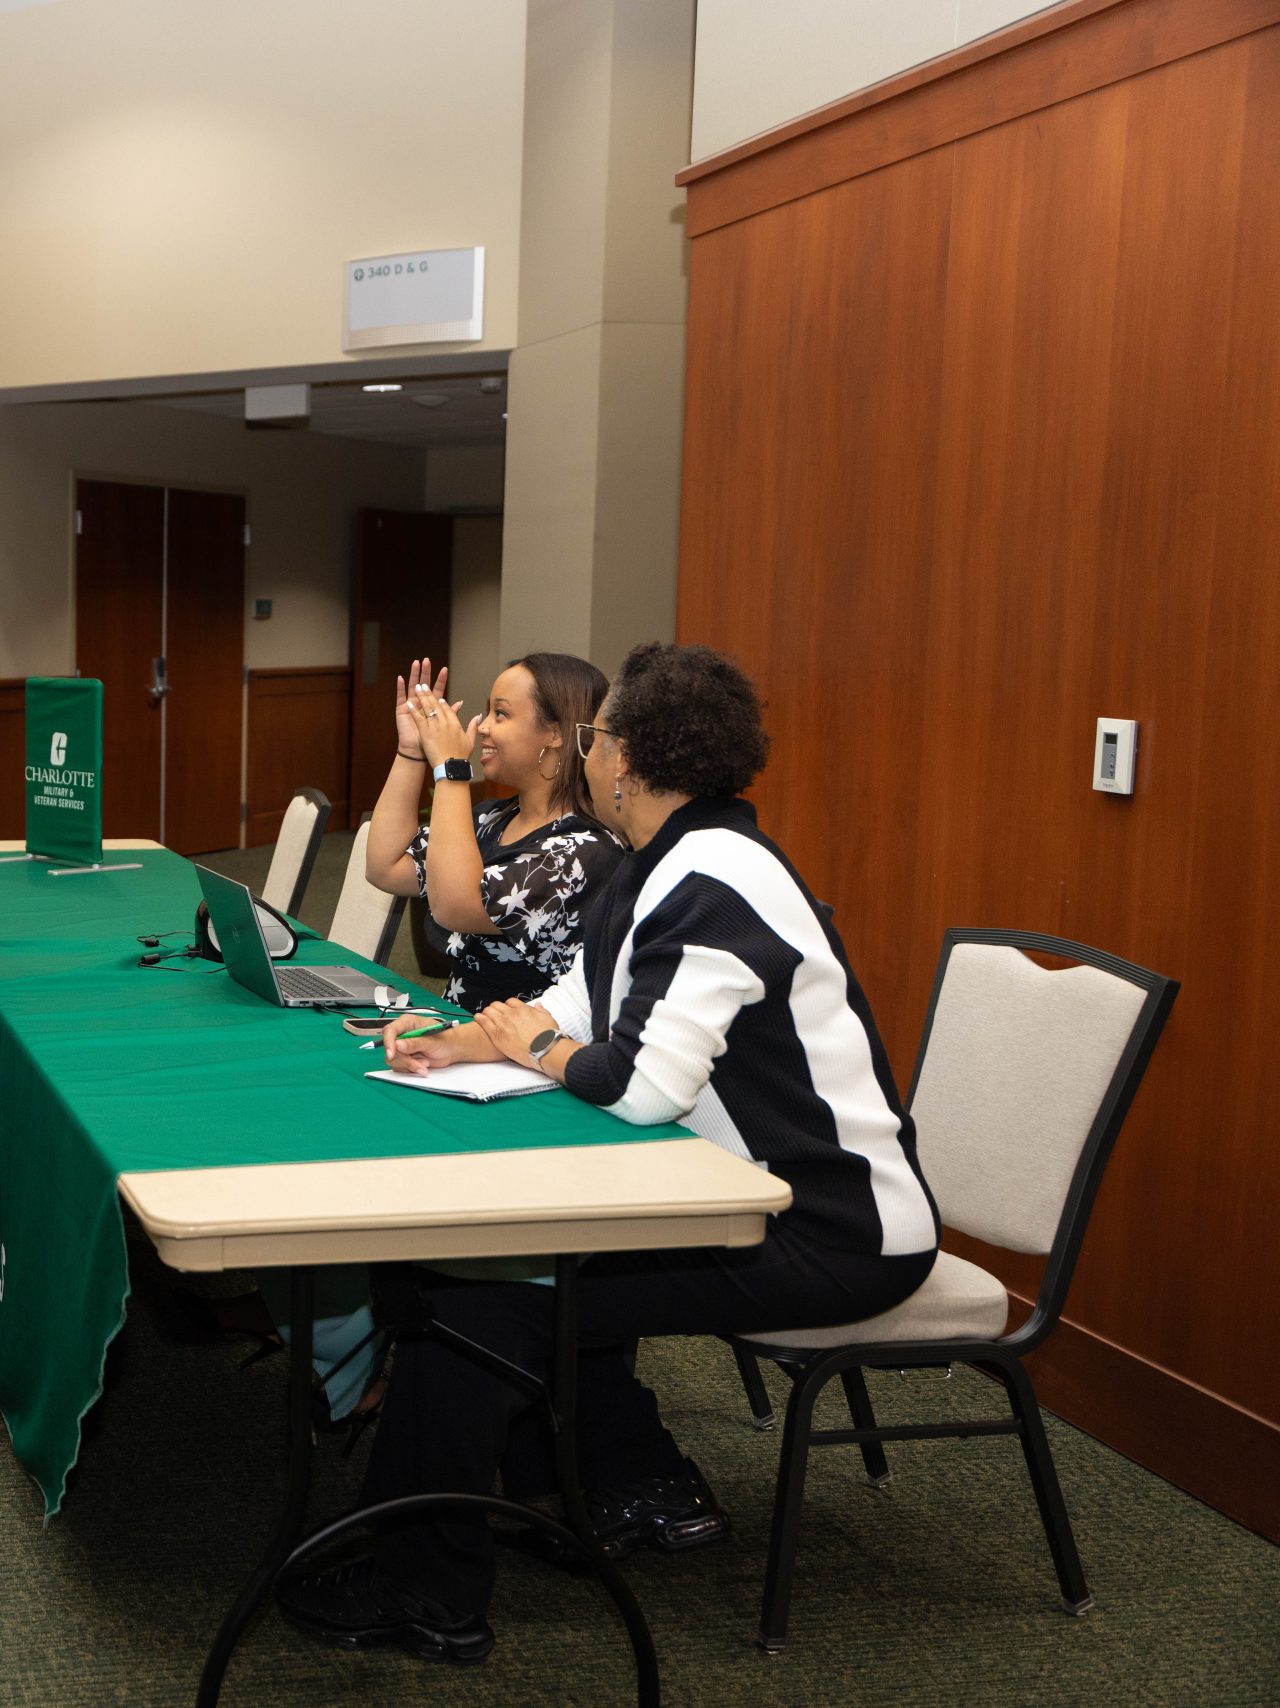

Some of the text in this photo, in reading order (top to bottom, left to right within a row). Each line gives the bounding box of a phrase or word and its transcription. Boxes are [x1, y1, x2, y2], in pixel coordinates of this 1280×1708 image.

[367, 260, 429, 279] 340 D & G
[24, 765, 95, 788] CHARLOTTE
[43, 785, 74, 798] MILITARY &
[34, 795, 85, 811] VETERAN SERVICES
